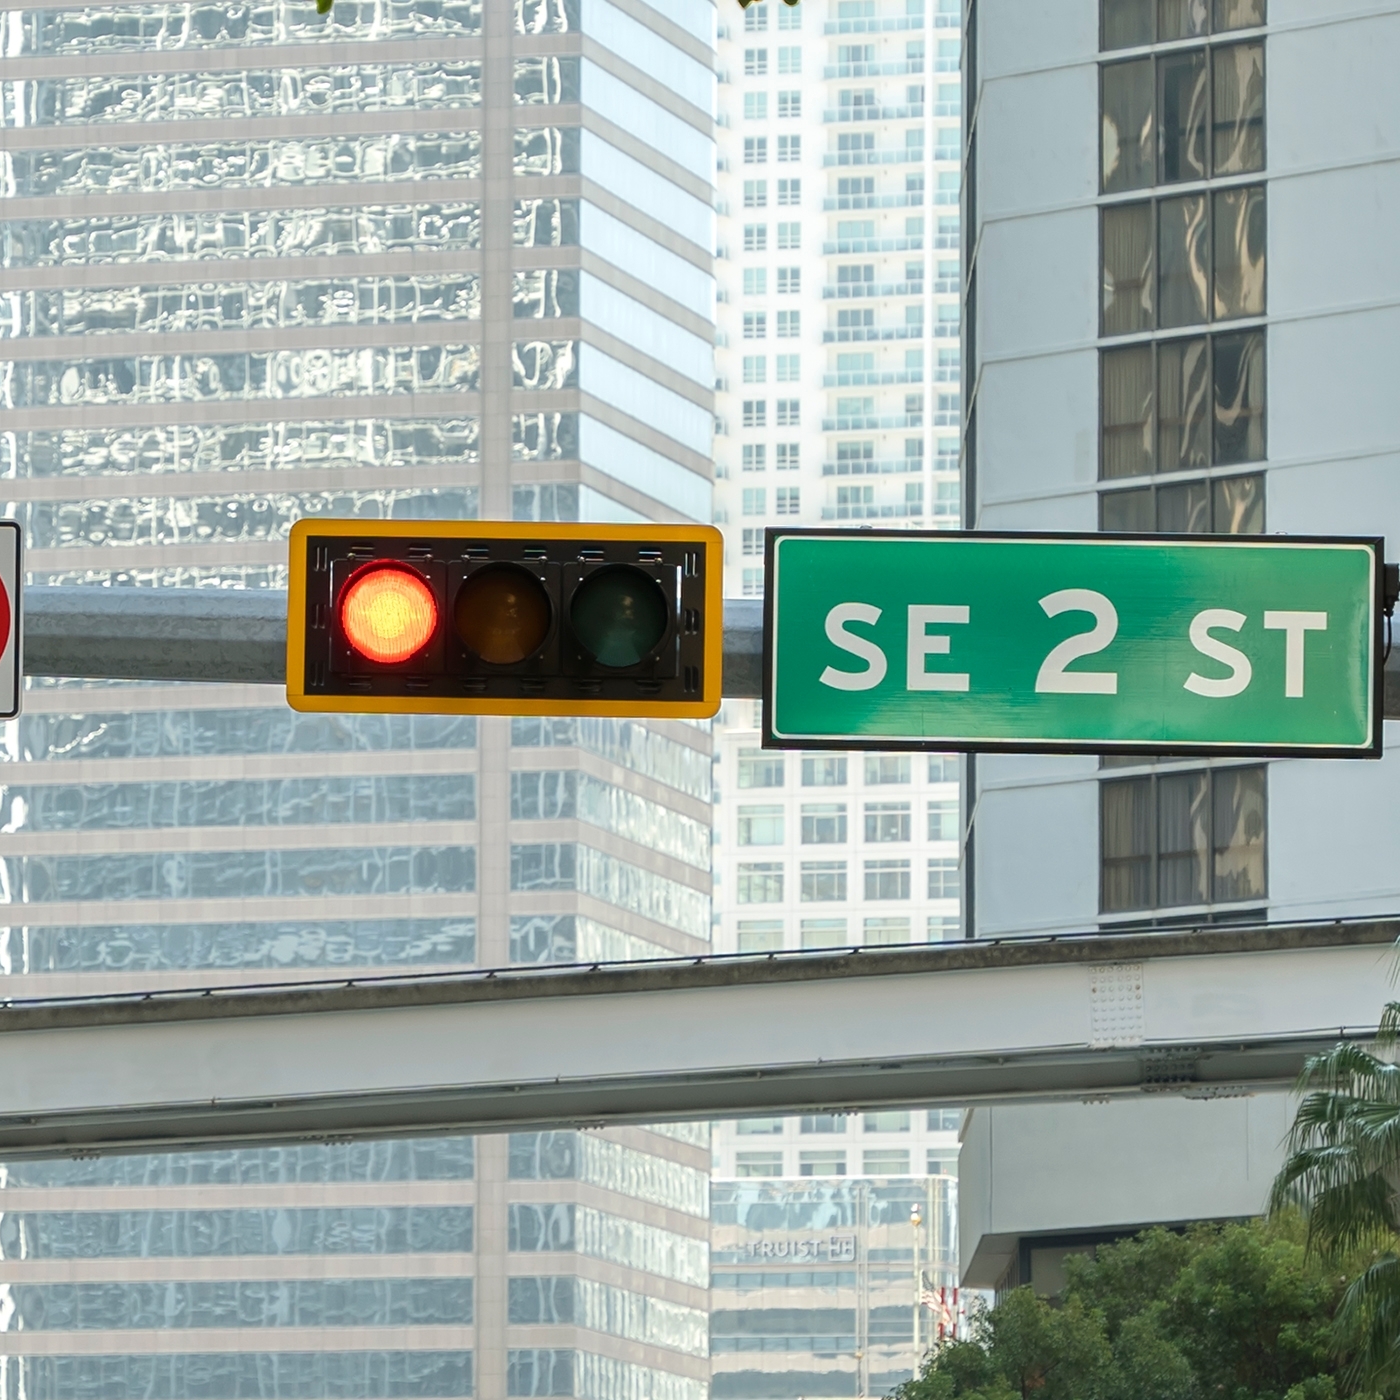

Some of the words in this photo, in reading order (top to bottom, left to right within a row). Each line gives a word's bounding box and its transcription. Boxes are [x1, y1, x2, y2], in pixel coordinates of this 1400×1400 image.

[819, 602, 970, 692] SE
[1035, 588, 1119, 694] 2
[1184, 608, 1328, 698] ST
[748, 1240, 822, 1257] TRUIST
